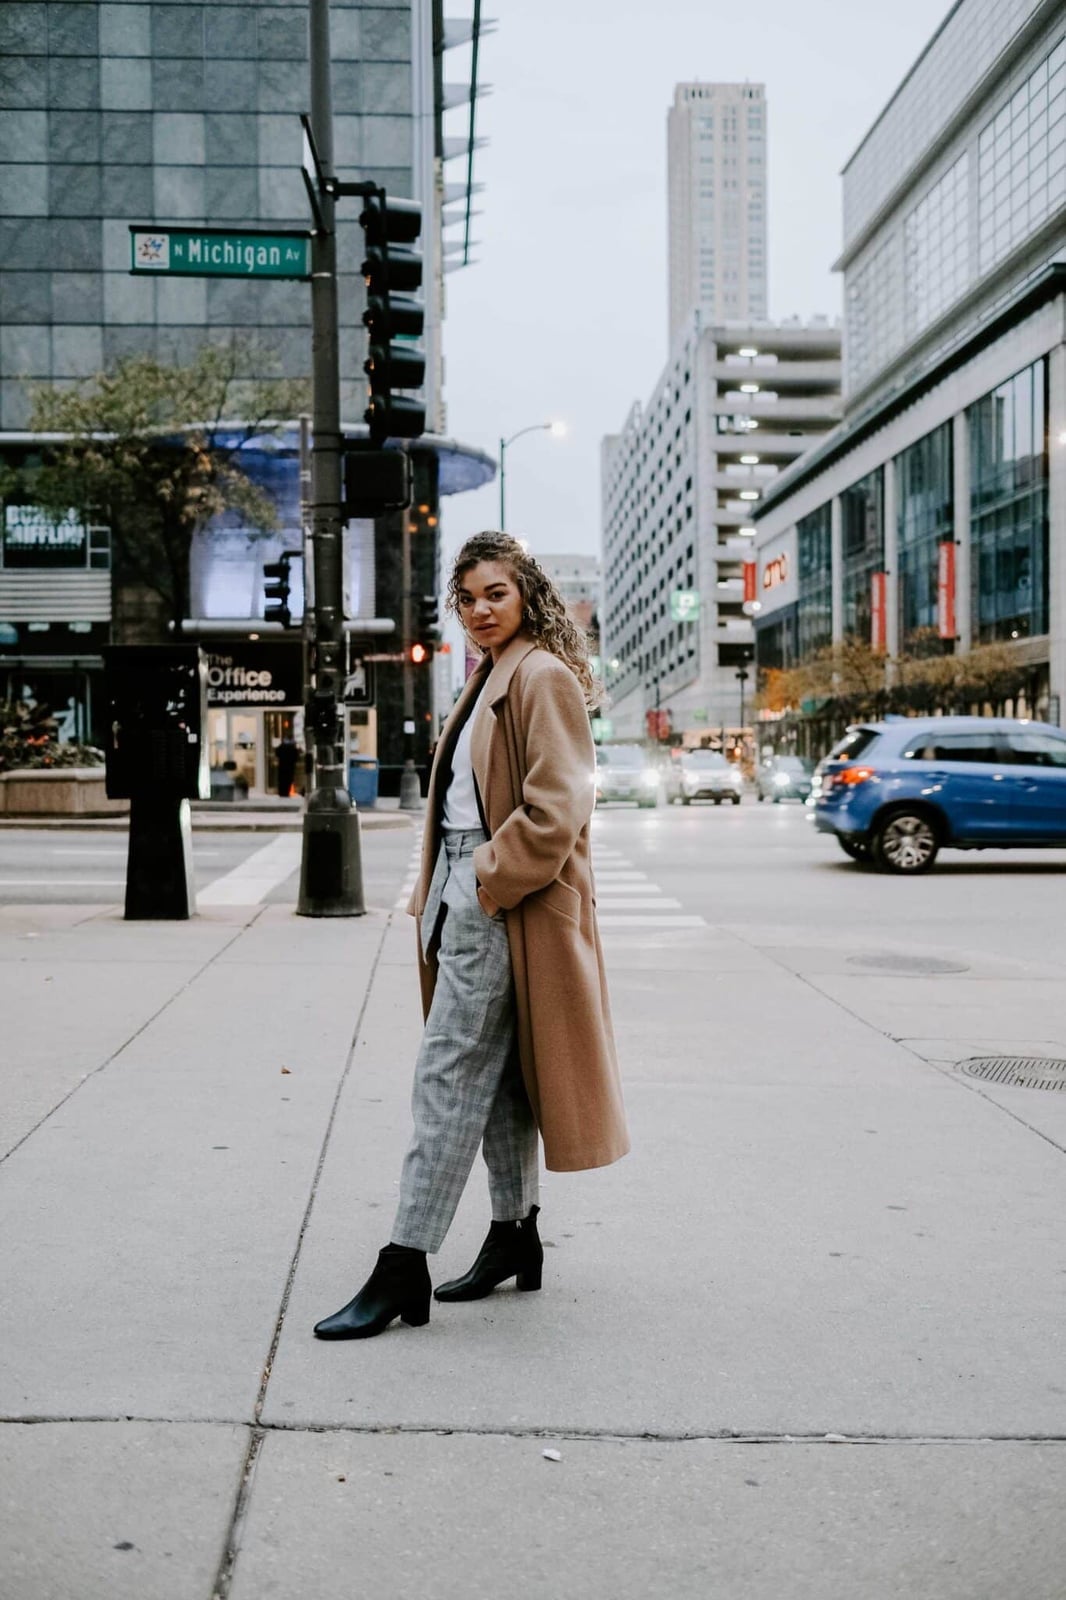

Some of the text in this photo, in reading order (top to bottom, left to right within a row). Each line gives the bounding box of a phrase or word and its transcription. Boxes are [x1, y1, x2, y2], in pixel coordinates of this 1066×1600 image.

[174, 238, 300, 272] N Michigan Av
[208, 667, 273, 687] Office
[207, 688, 286, 703] Experience
